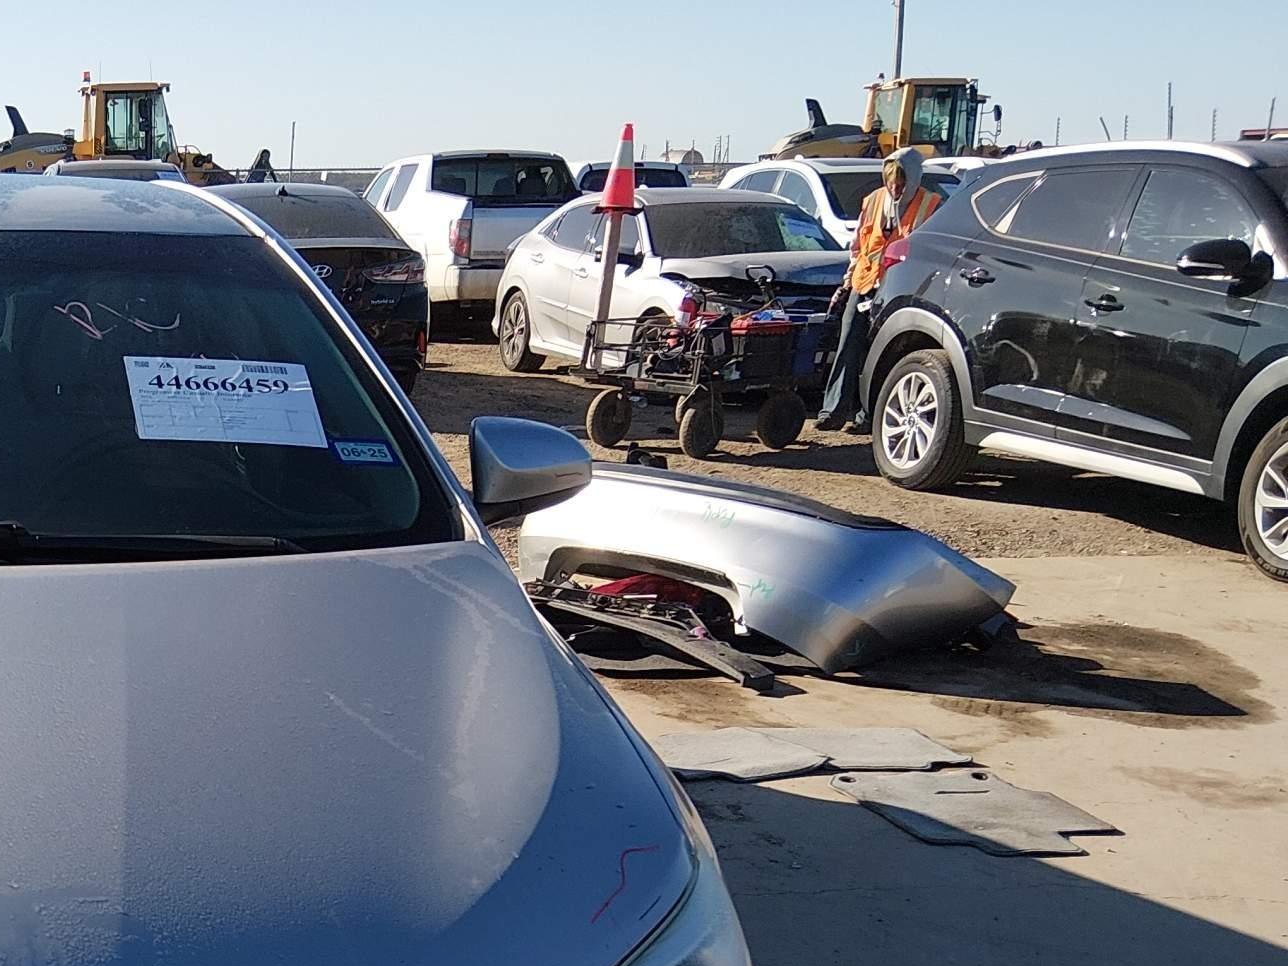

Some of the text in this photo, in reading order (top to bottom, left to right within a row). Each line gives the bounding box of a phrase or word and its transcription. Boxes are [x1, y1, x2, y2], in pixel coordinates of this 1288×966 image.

[148, 374, 289, 395] 44666459
[341, 447, 388, 458] 06 25
